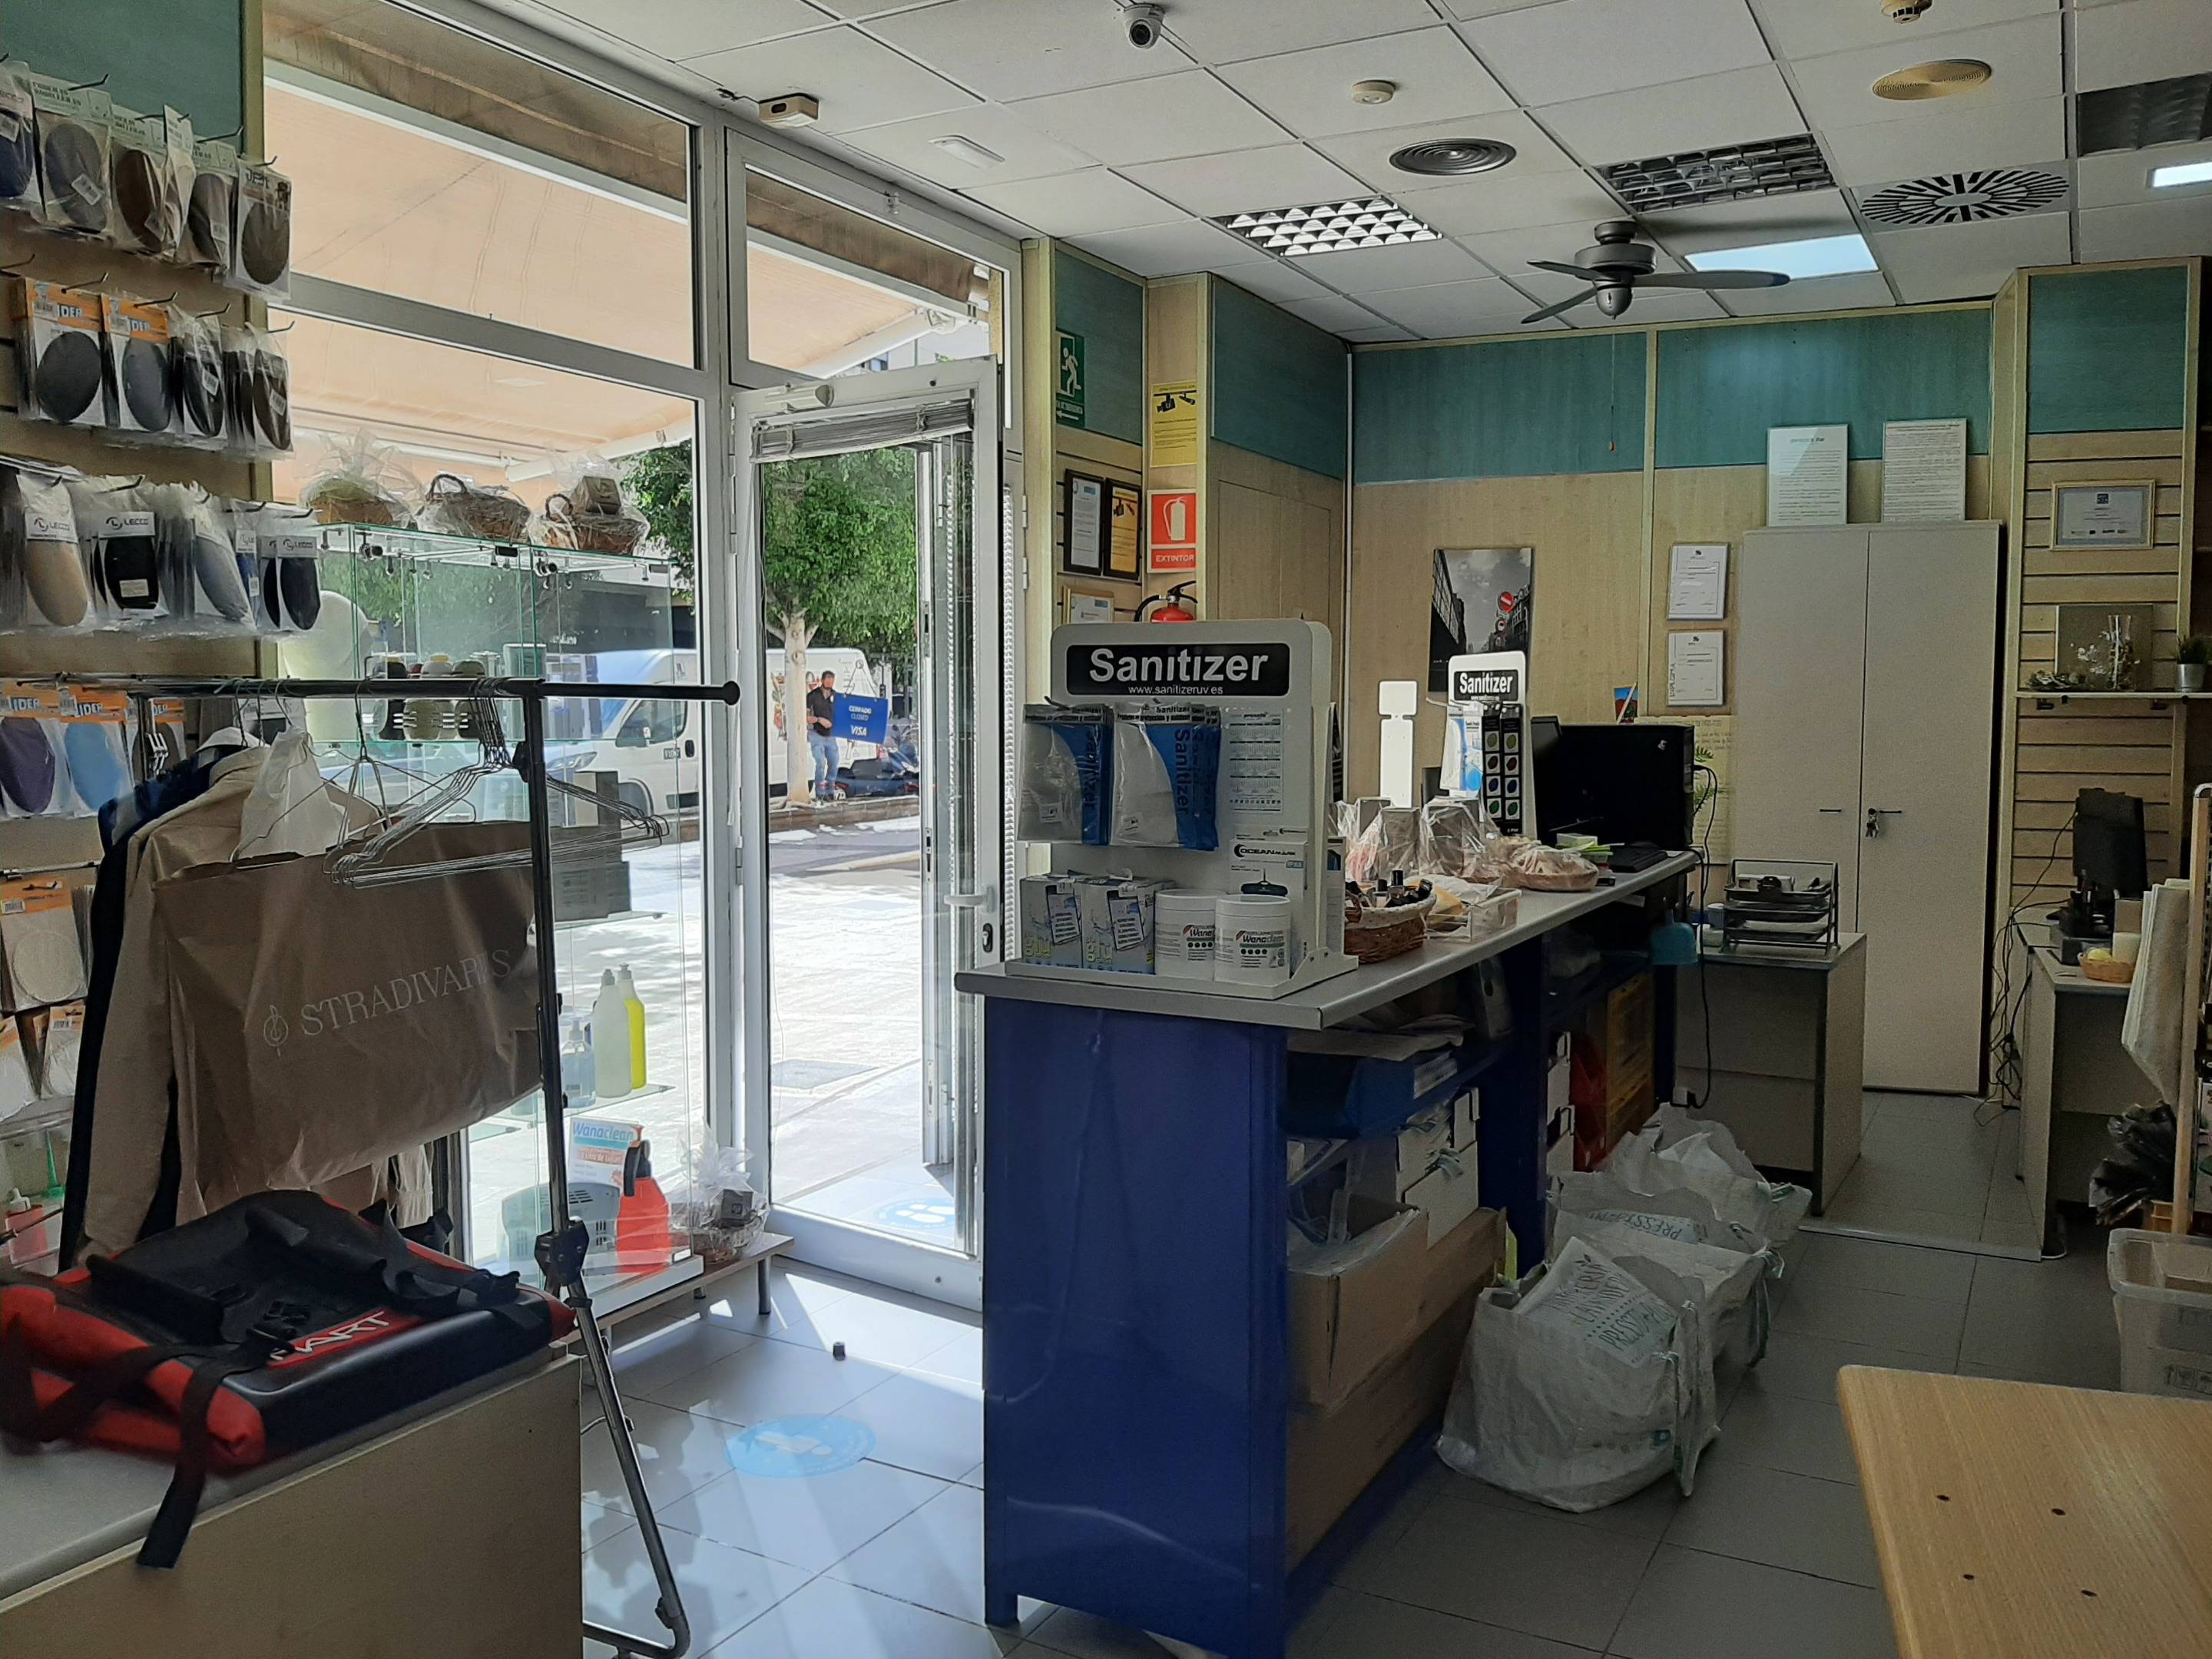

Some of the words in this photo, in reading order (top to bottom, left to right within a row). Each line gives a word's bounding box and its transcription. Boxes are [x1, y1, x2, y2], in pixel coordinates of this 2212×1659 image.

[1155, 554, 1195, 563] EXTINTOR
[1089, 647, 1269, 682] Sanitizer
[1459, 671, 1513, 694] Sanitizer
[850, 725, 867, 736] VISA
[1174, 729, 1190, 814] Sanitizer
